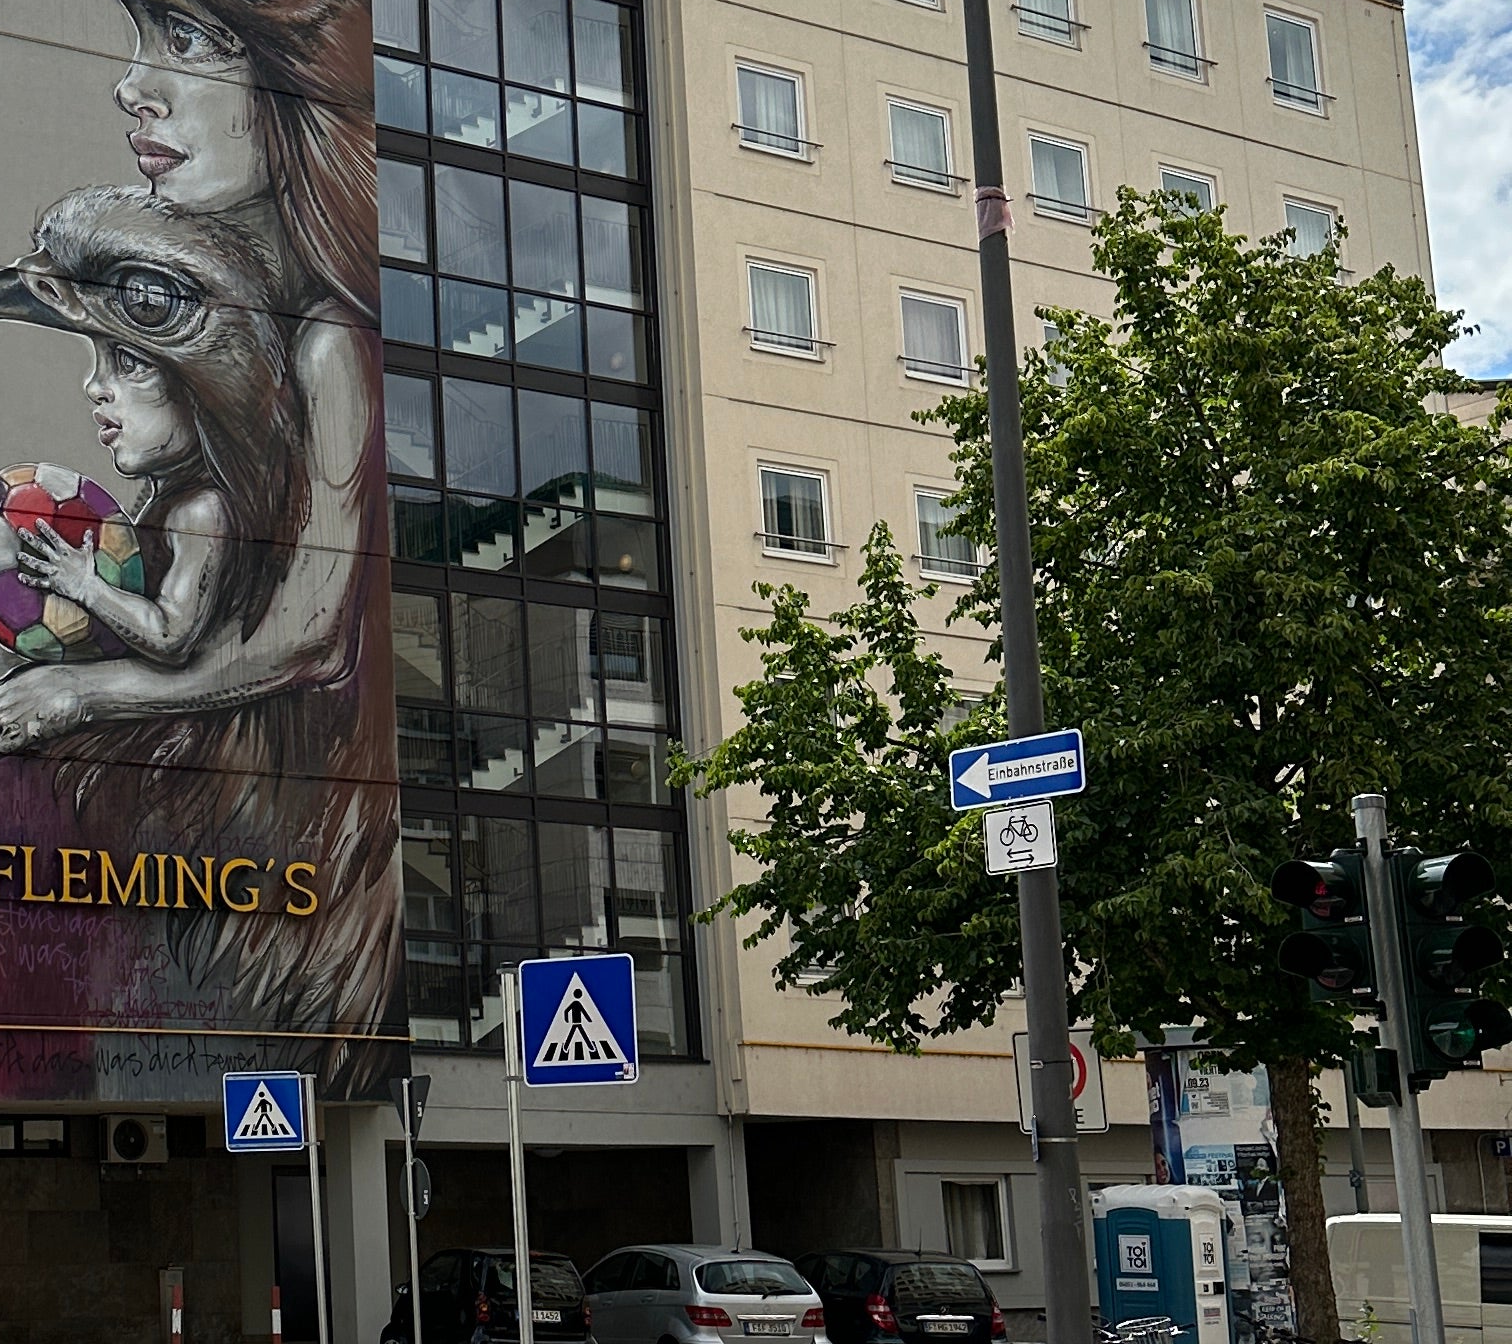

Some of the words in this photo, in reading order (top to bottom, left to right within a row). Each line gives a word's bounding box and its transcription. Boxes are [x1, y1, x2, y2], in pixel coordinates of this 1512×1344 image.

[987, 755, 1076, 782] Einbahnstraße
[1495, 1140, 1507, 1154] P
[1127, 1258, 1147, 1269] TOI
